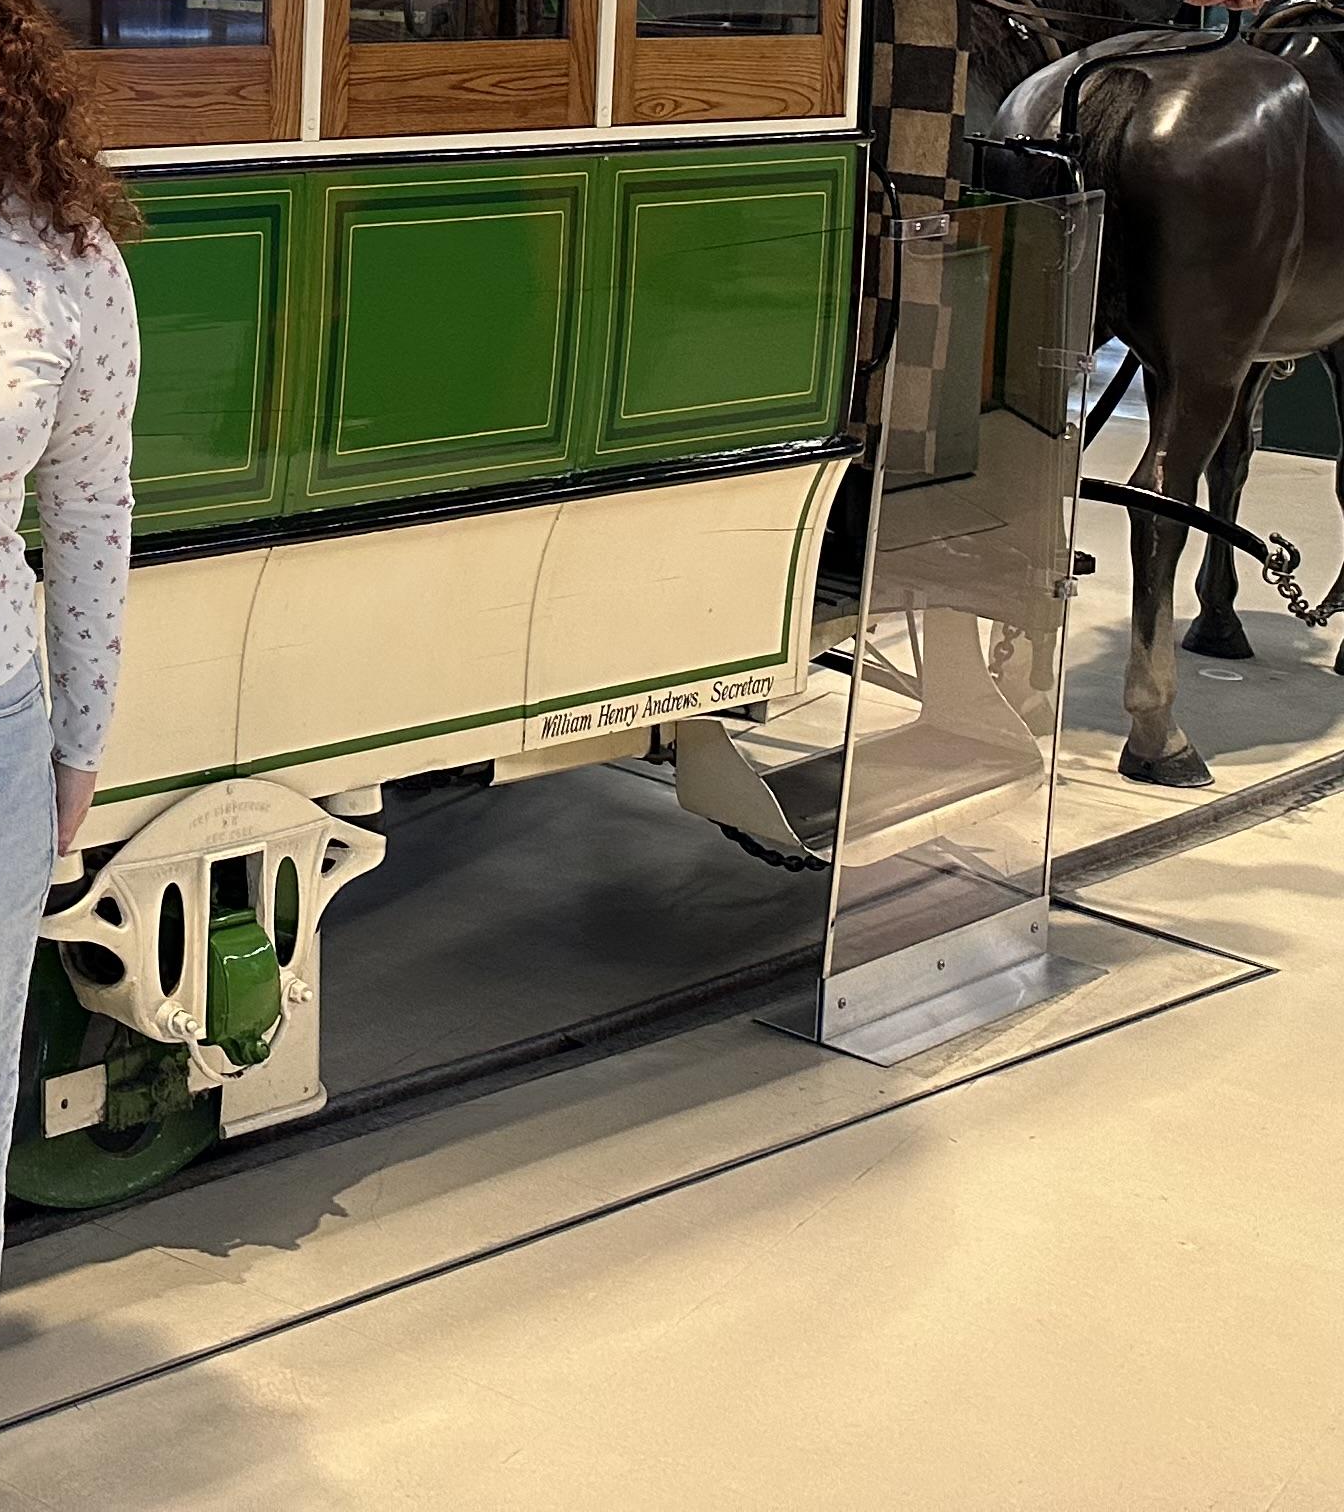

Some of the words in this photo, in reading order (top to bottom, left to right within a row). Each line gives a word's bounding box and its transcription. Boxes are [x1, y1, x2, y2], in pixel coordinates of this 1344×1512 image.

[541, 711, 592, 740] William
[597, 703, 639, 728] Henry
[710, 675, 775, 703] Secretary
